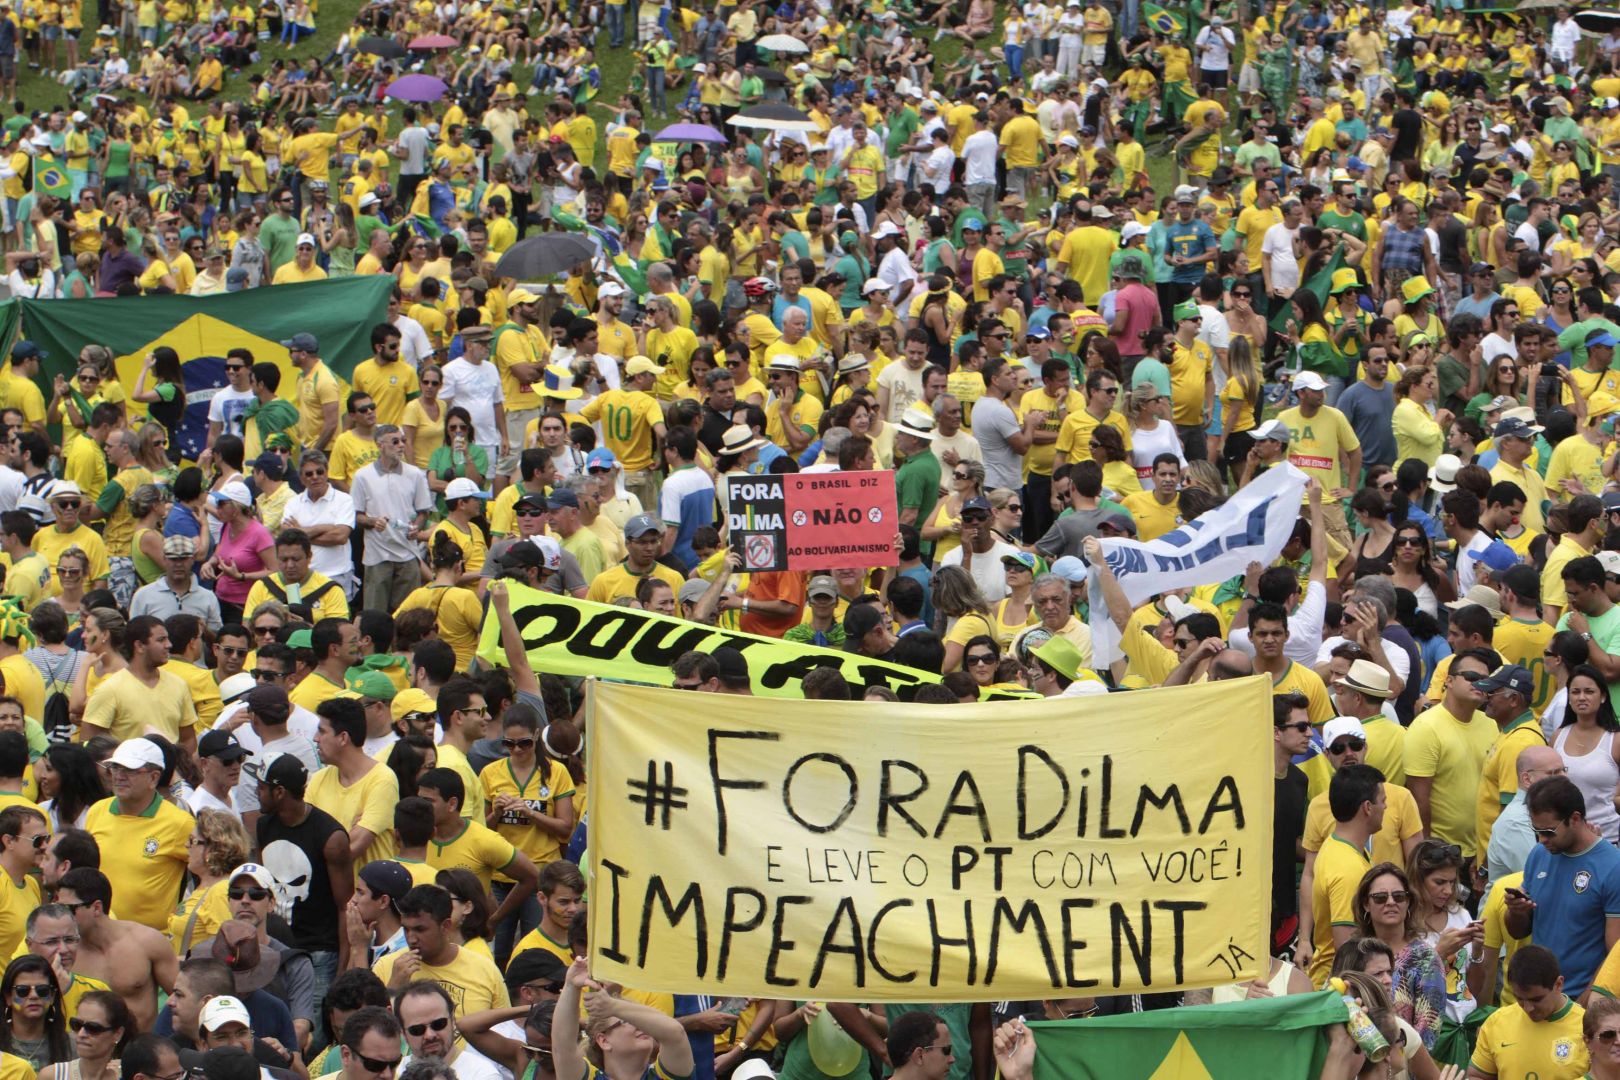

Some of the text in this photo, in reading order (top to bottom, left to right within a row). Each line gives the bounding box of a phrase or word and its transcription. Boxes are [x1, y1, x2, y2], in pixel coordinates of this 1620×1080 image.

[607, 403, 632, 441] 10
[730, 483, 784, 501] FORA
[796, 478, 878, 490] O BRASIL DIZ
[813, 502, 862, 526] NÃO
[788, 544, 890, 556] AO BOLIVARIANISMO
[767, 839, 1242, 892] E LEVE O PT COM VOCÊ!
[599, 858, 1208, 989] IMPEACHMENT
